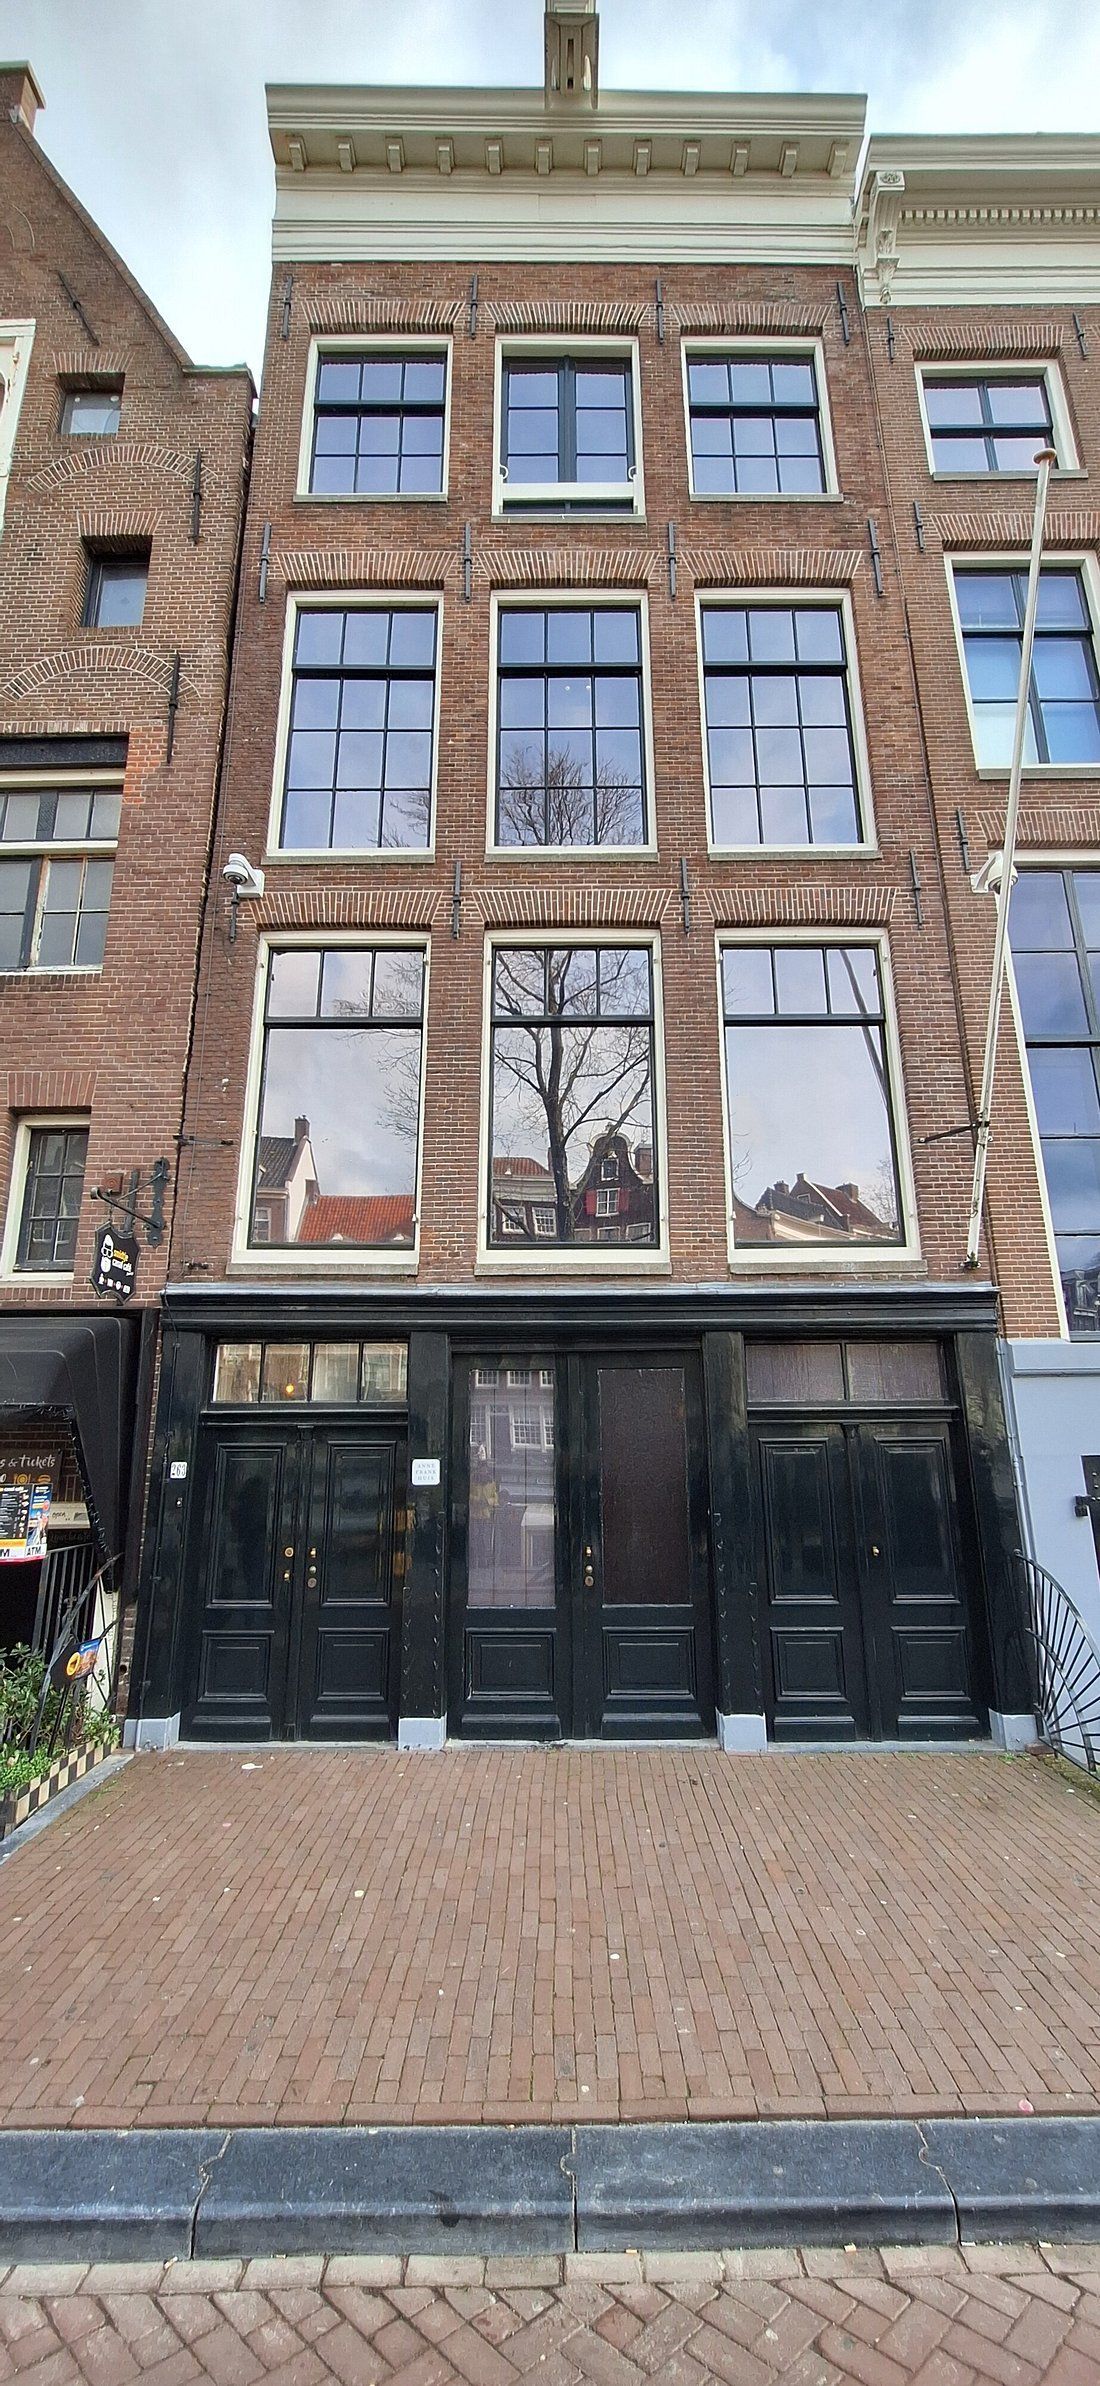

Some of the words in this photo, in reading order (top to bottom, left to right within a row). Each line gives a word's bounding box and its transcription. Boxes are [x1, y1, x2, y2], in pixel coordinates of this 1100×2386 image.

[8, 1458, 18, 1468] &
[171, 1463, 186, 1477] 263
[26, 1546, 42, 1556] ATM
